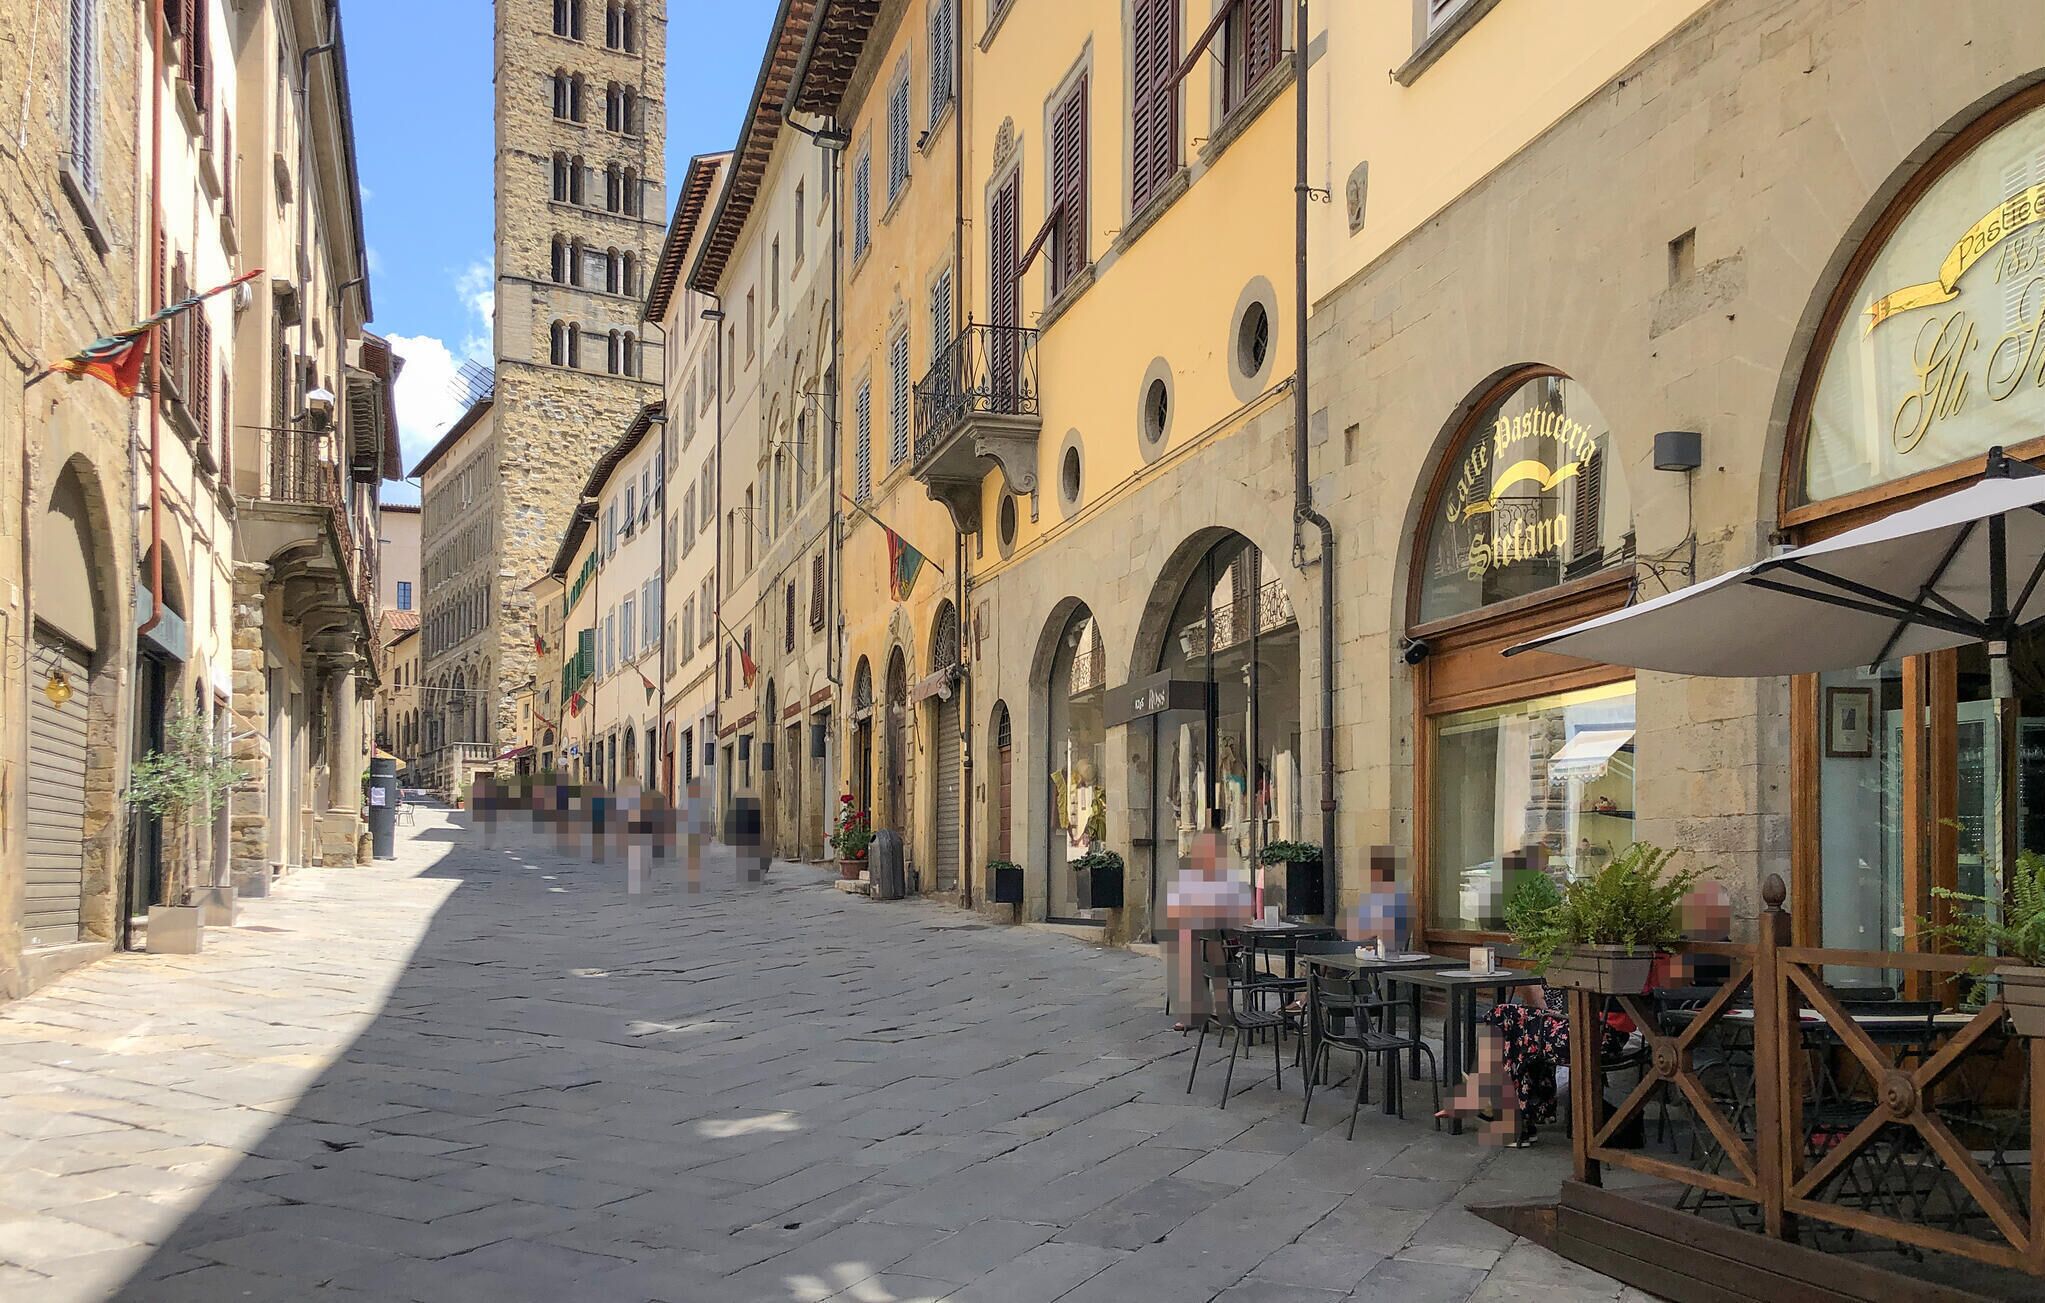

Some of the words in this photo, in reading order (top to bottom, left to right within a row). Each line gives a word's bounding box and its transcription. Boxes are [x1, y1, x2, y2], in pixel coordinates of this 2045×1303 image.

[1994, 227, 2045, 284] 185
[1893, 311, 1979, 454] Gli
[1494, 403, 1596, 466] Pasticceria
[1468, 514, 1566, 580] Stefano
